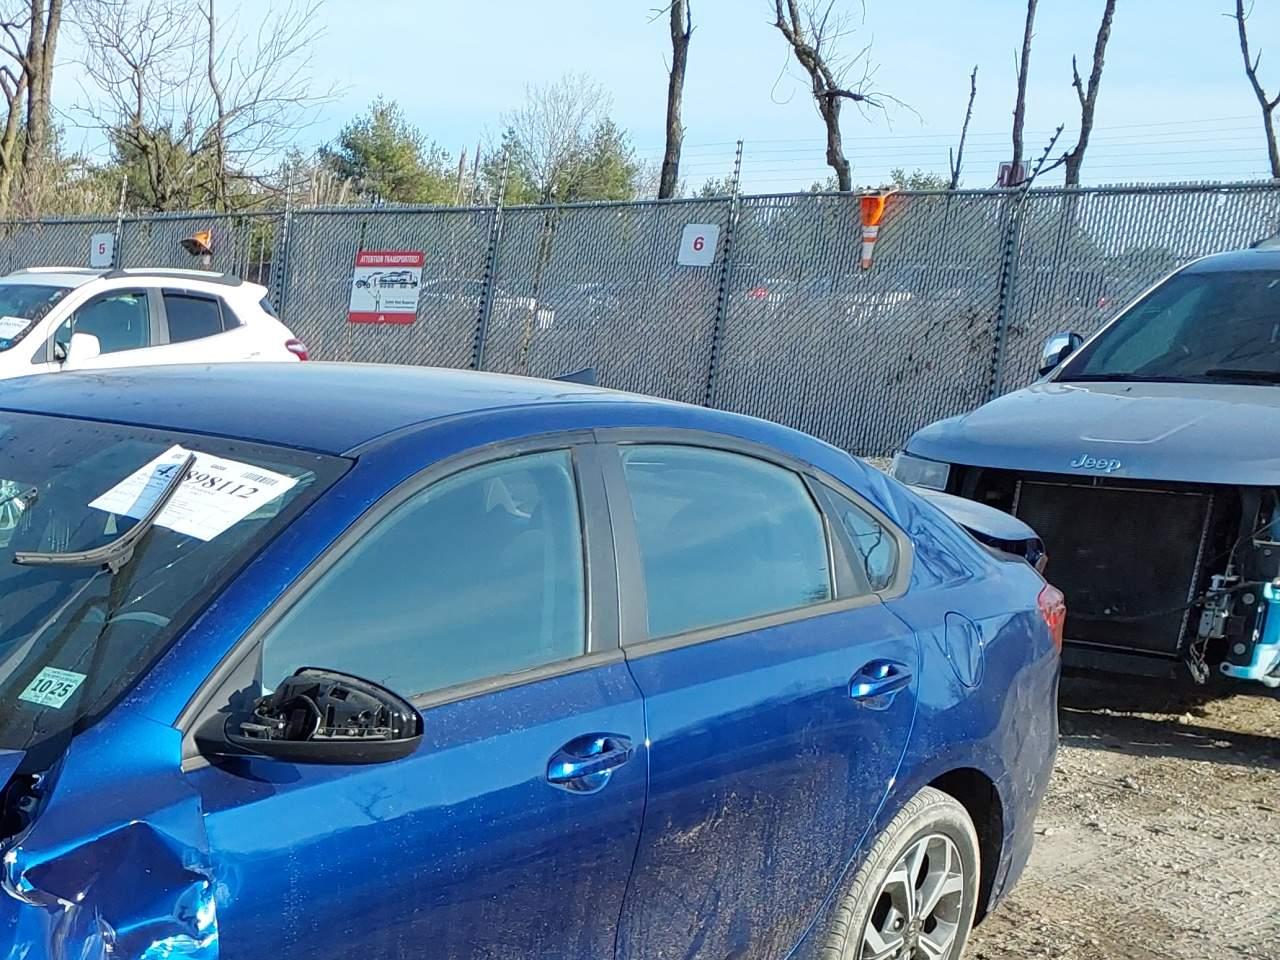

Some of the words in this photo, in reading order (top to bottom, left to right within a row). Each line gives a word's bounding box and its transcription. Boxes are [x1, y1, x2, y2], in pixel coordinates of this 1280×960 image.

[98, 242, 106, 255] 5
[693, 236, 705, 251] 6
[360, 254, 384, 264] ATTENTION
[384, 254, 420, 264] TRANSPORTERS!
[1070, 453, 1122, 473] Jeep
[157, 464, 260, 499] 4898112
[31, 678, 53, 693] 10
[48, 682, 74, 697] 25
